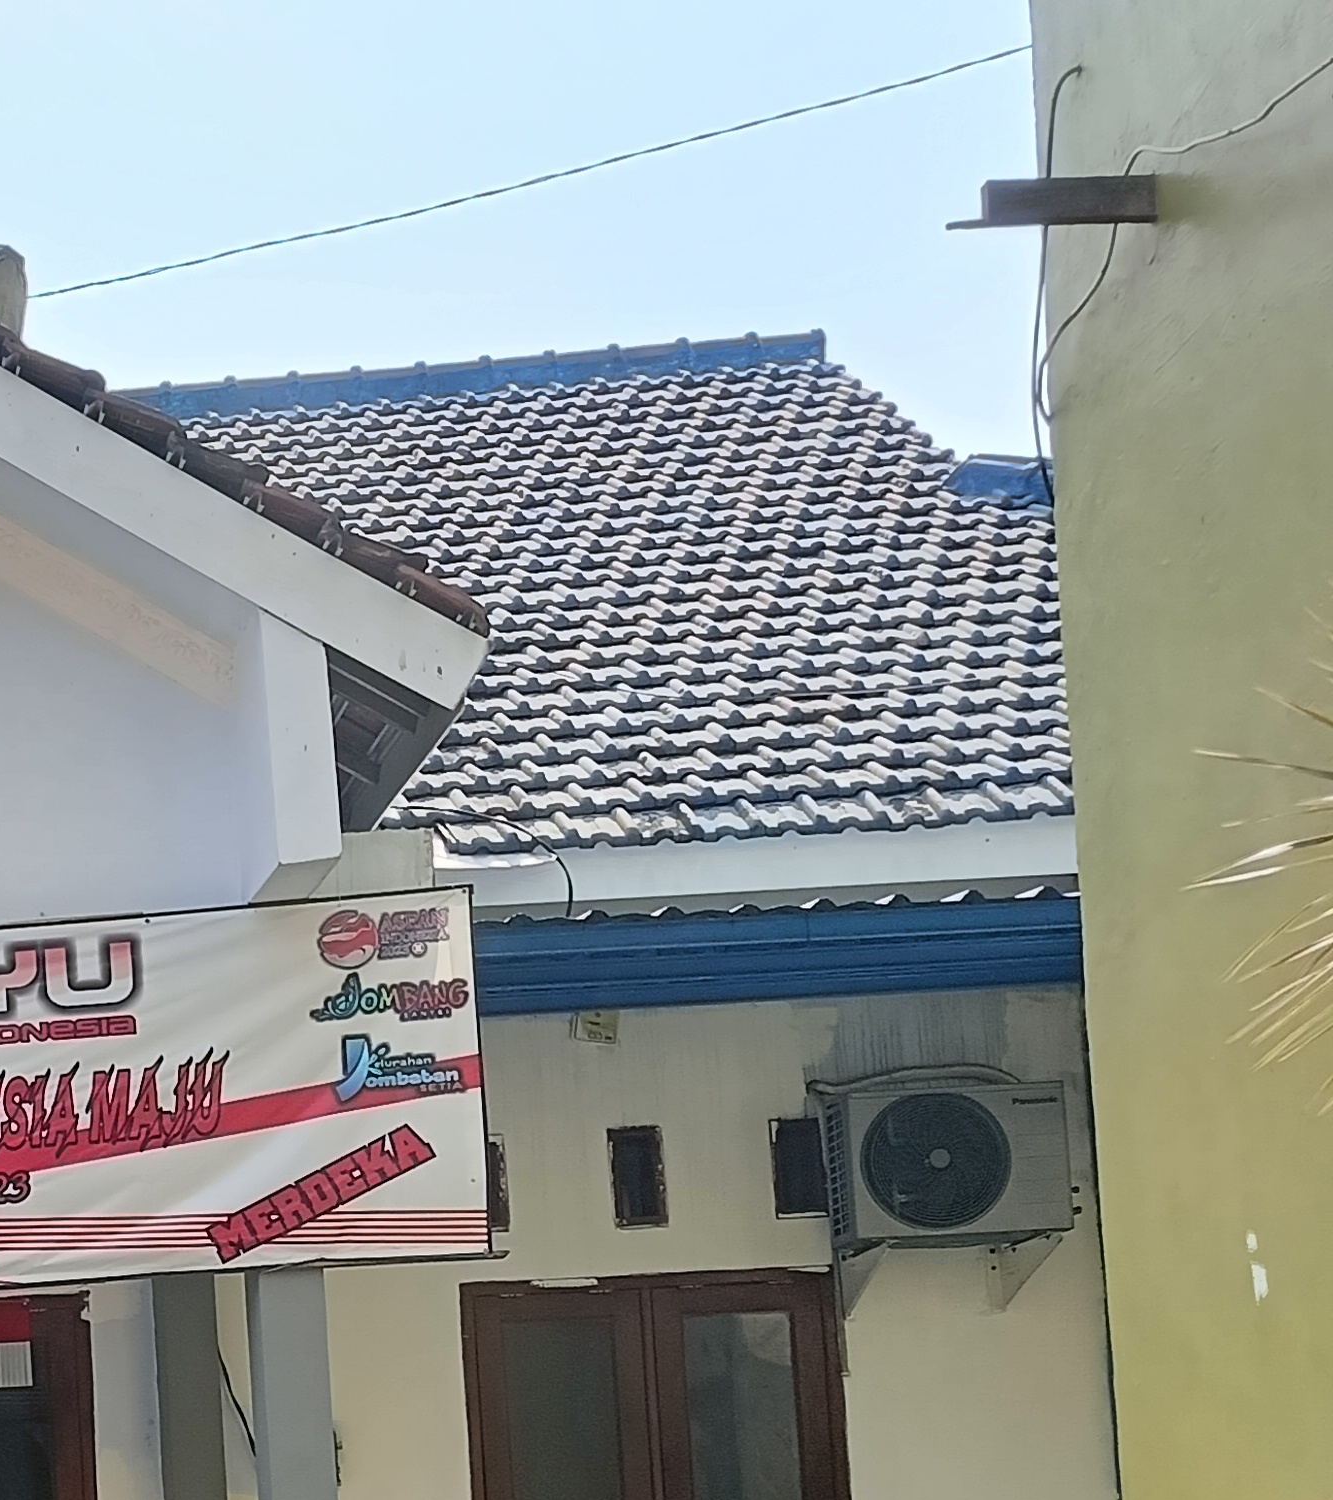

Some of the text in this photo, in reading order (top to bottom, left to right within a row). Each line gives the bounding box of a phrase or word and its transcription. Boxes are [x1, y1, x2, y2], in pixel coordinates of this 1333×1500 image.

[379, 908, 449, 932] ASEAN
[313, 973, 469, 1020] JOMBANG
[86, 1047, 231, 1154] MAJU
[417, 1080, 467, 1094] SETIA
[206, 1123, 437, 1264] MERDEKA
